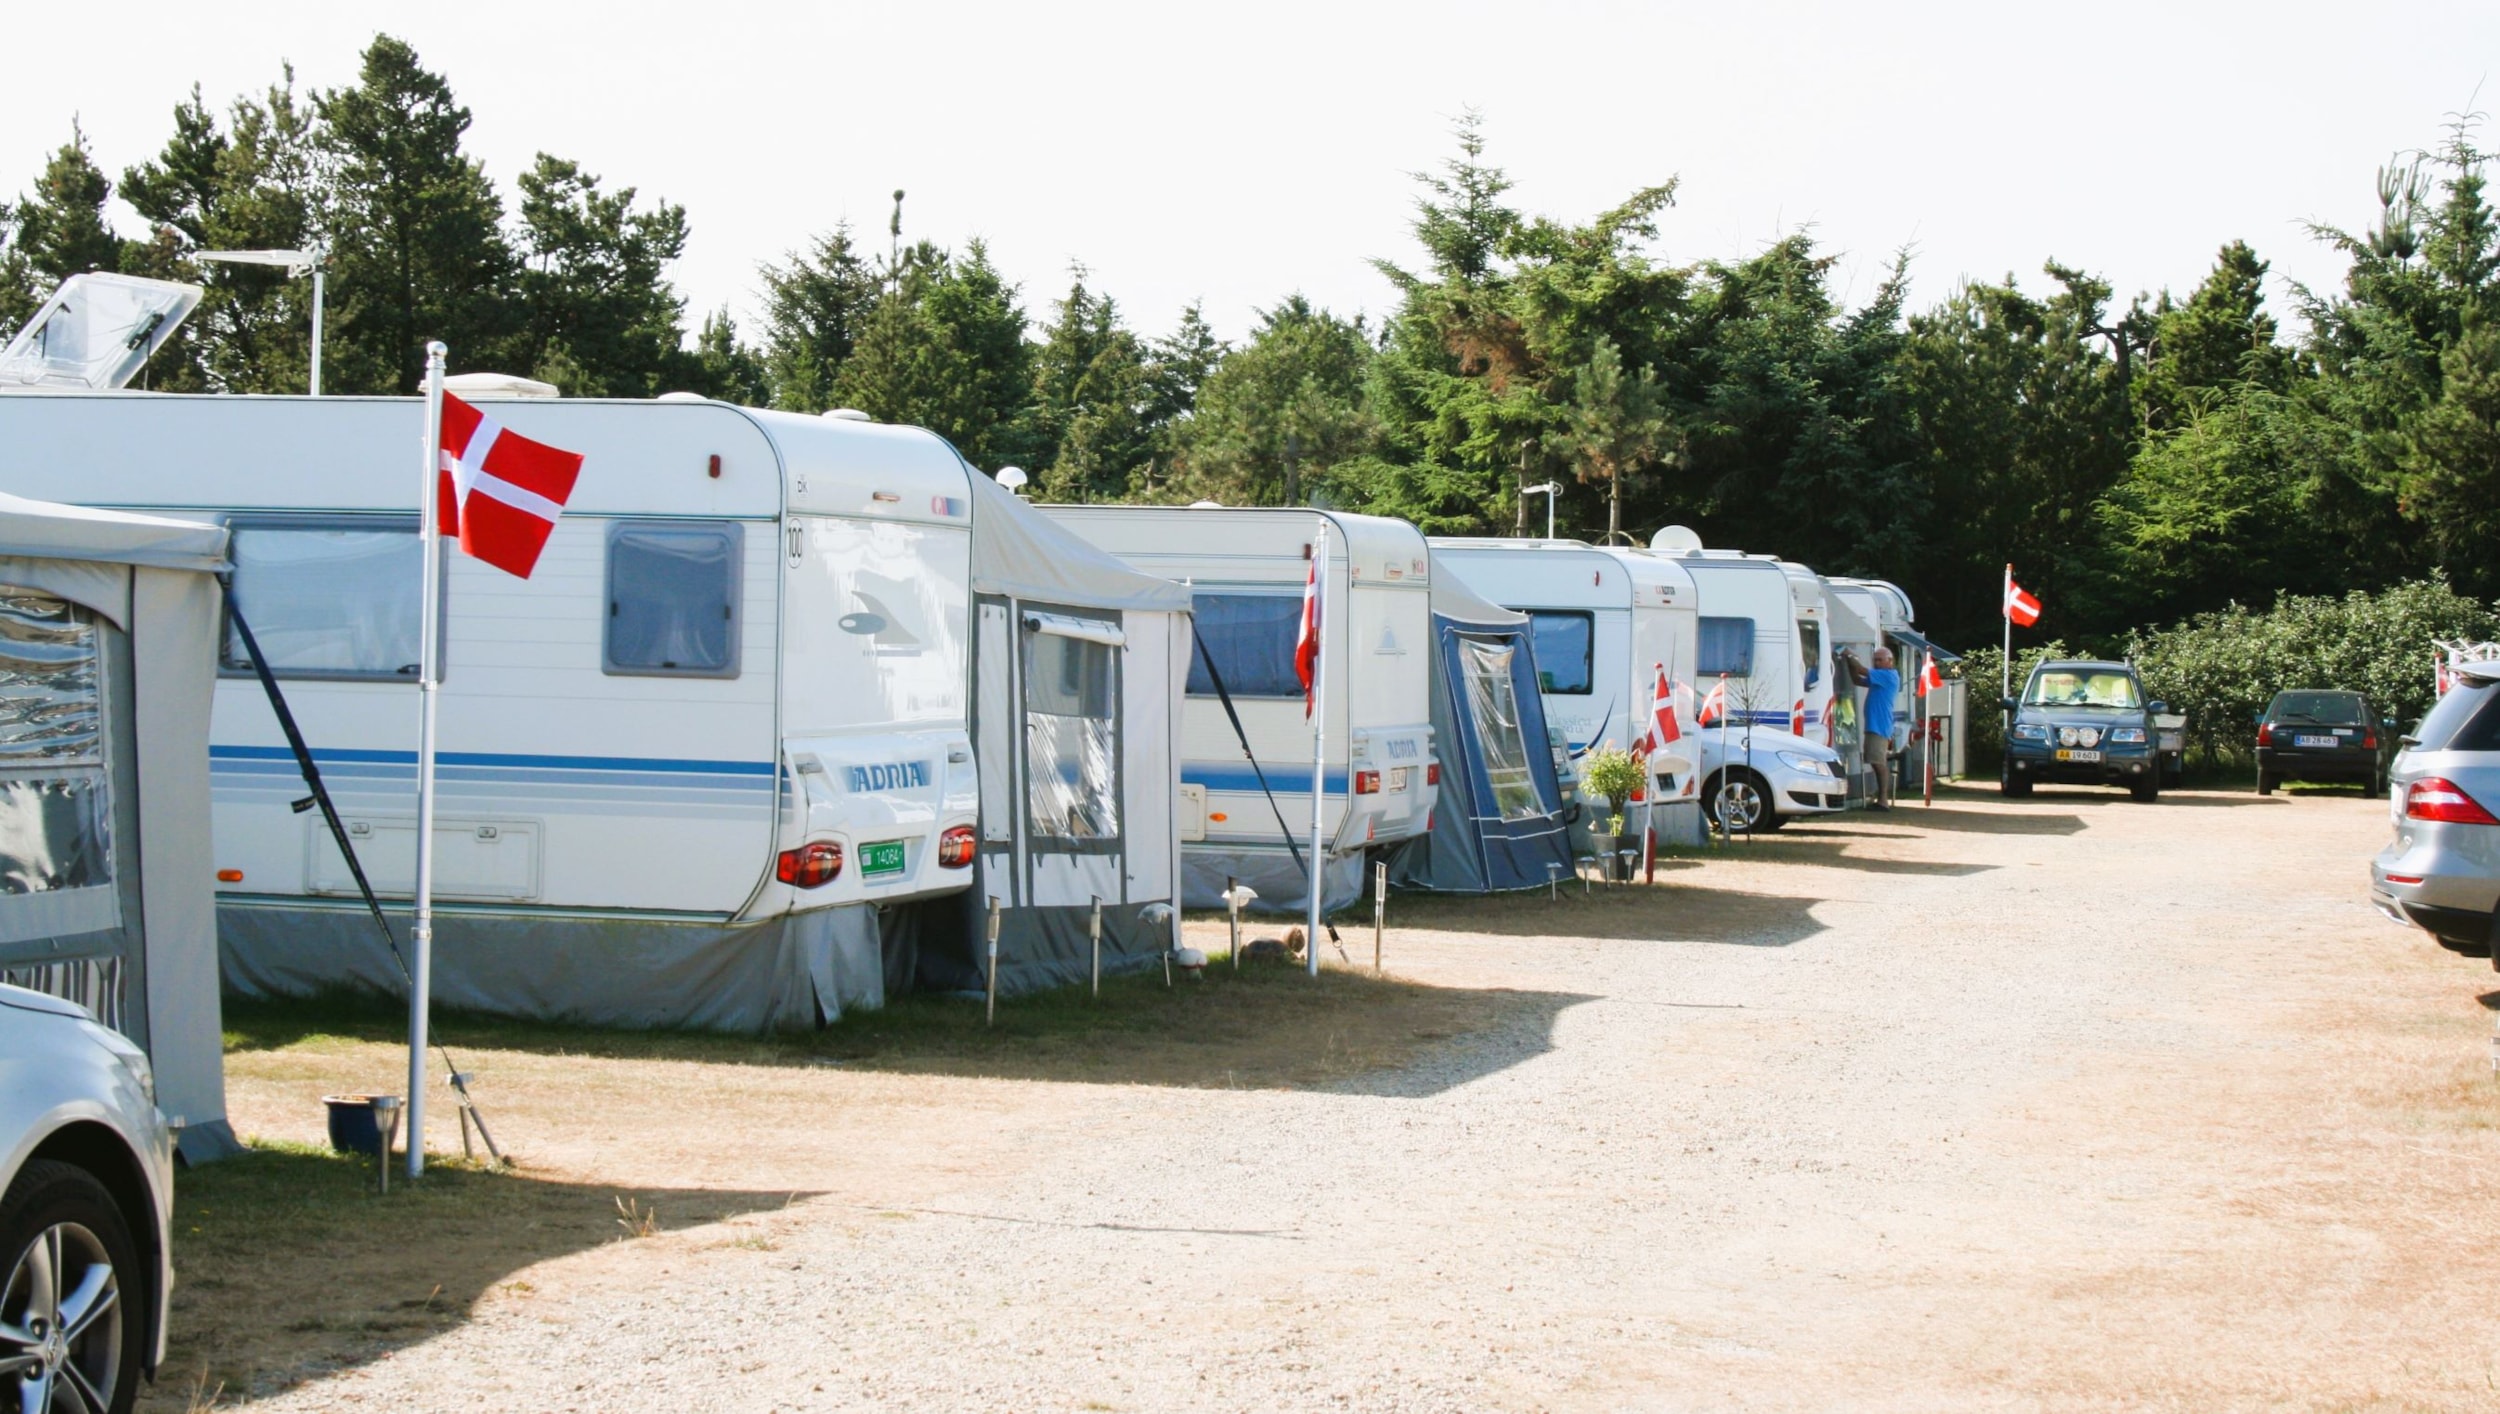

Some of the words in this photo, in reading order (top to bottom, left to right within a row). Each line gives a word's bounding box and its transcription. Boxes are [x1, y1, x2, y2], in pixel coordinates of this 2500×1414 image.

[797, 480, 808, 493] DK
[788, 527, 803, 558] 100
[1387, 739, 1418, 759] ADRIA
[2072, 751, 2081, 759] 19
[2082, 751, 2097, 759] 603
[853, 761, 925, 792] ADRIA
